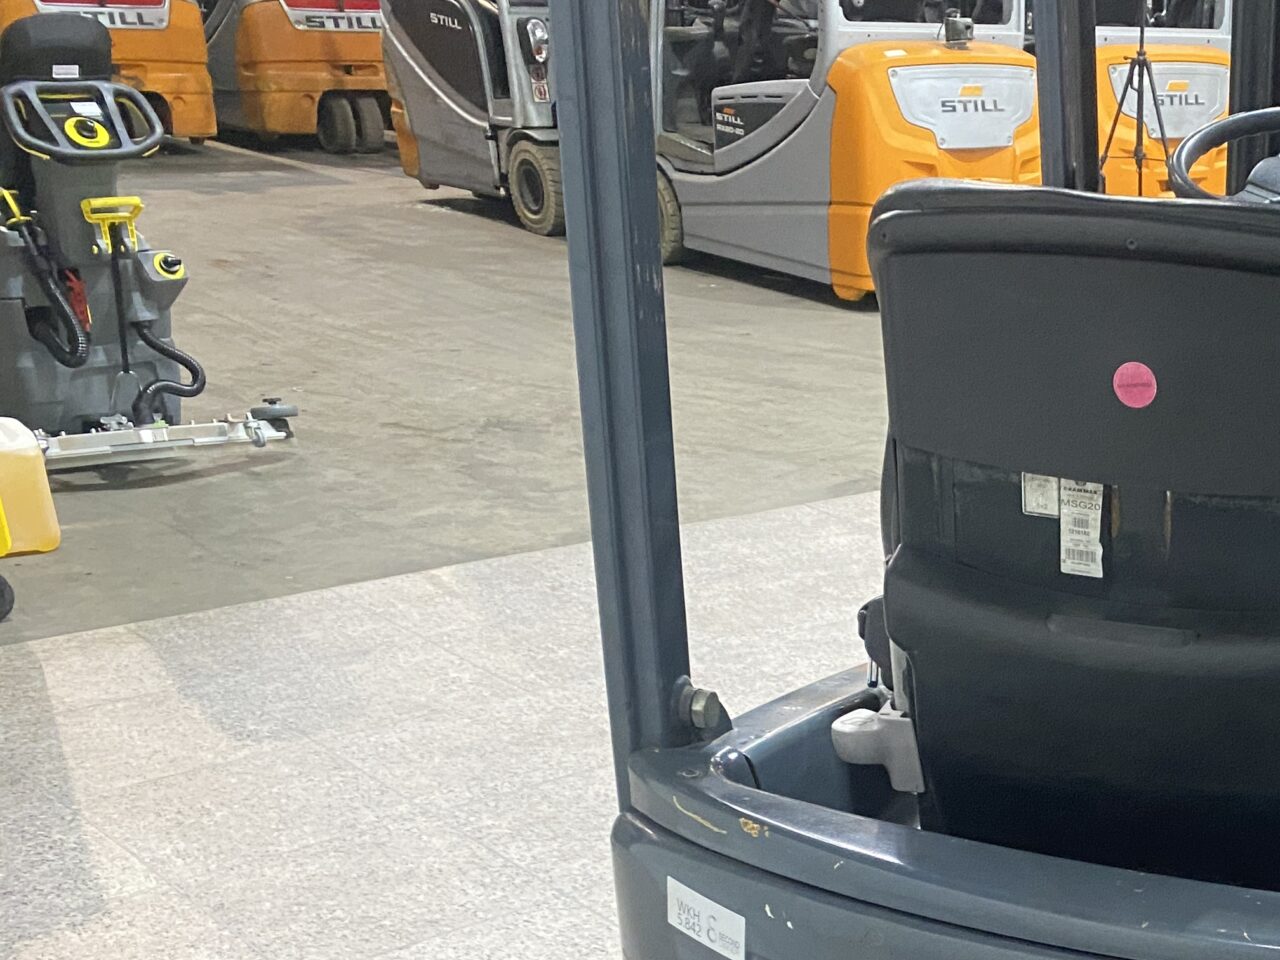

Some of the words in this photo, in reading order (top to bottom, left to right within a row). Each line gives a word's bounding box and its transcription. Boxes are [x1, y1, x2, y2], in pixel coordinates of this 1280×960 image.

[429, 12, 462, 30] STILL
[941, 99, 1005, 113] STILL
[1156, 94, 1205, 106] STILL
[716, 112, 744, 125] STILL
[1060, 499, 1101, 511] MSG20
[677, 897, 700, 922] WKH
